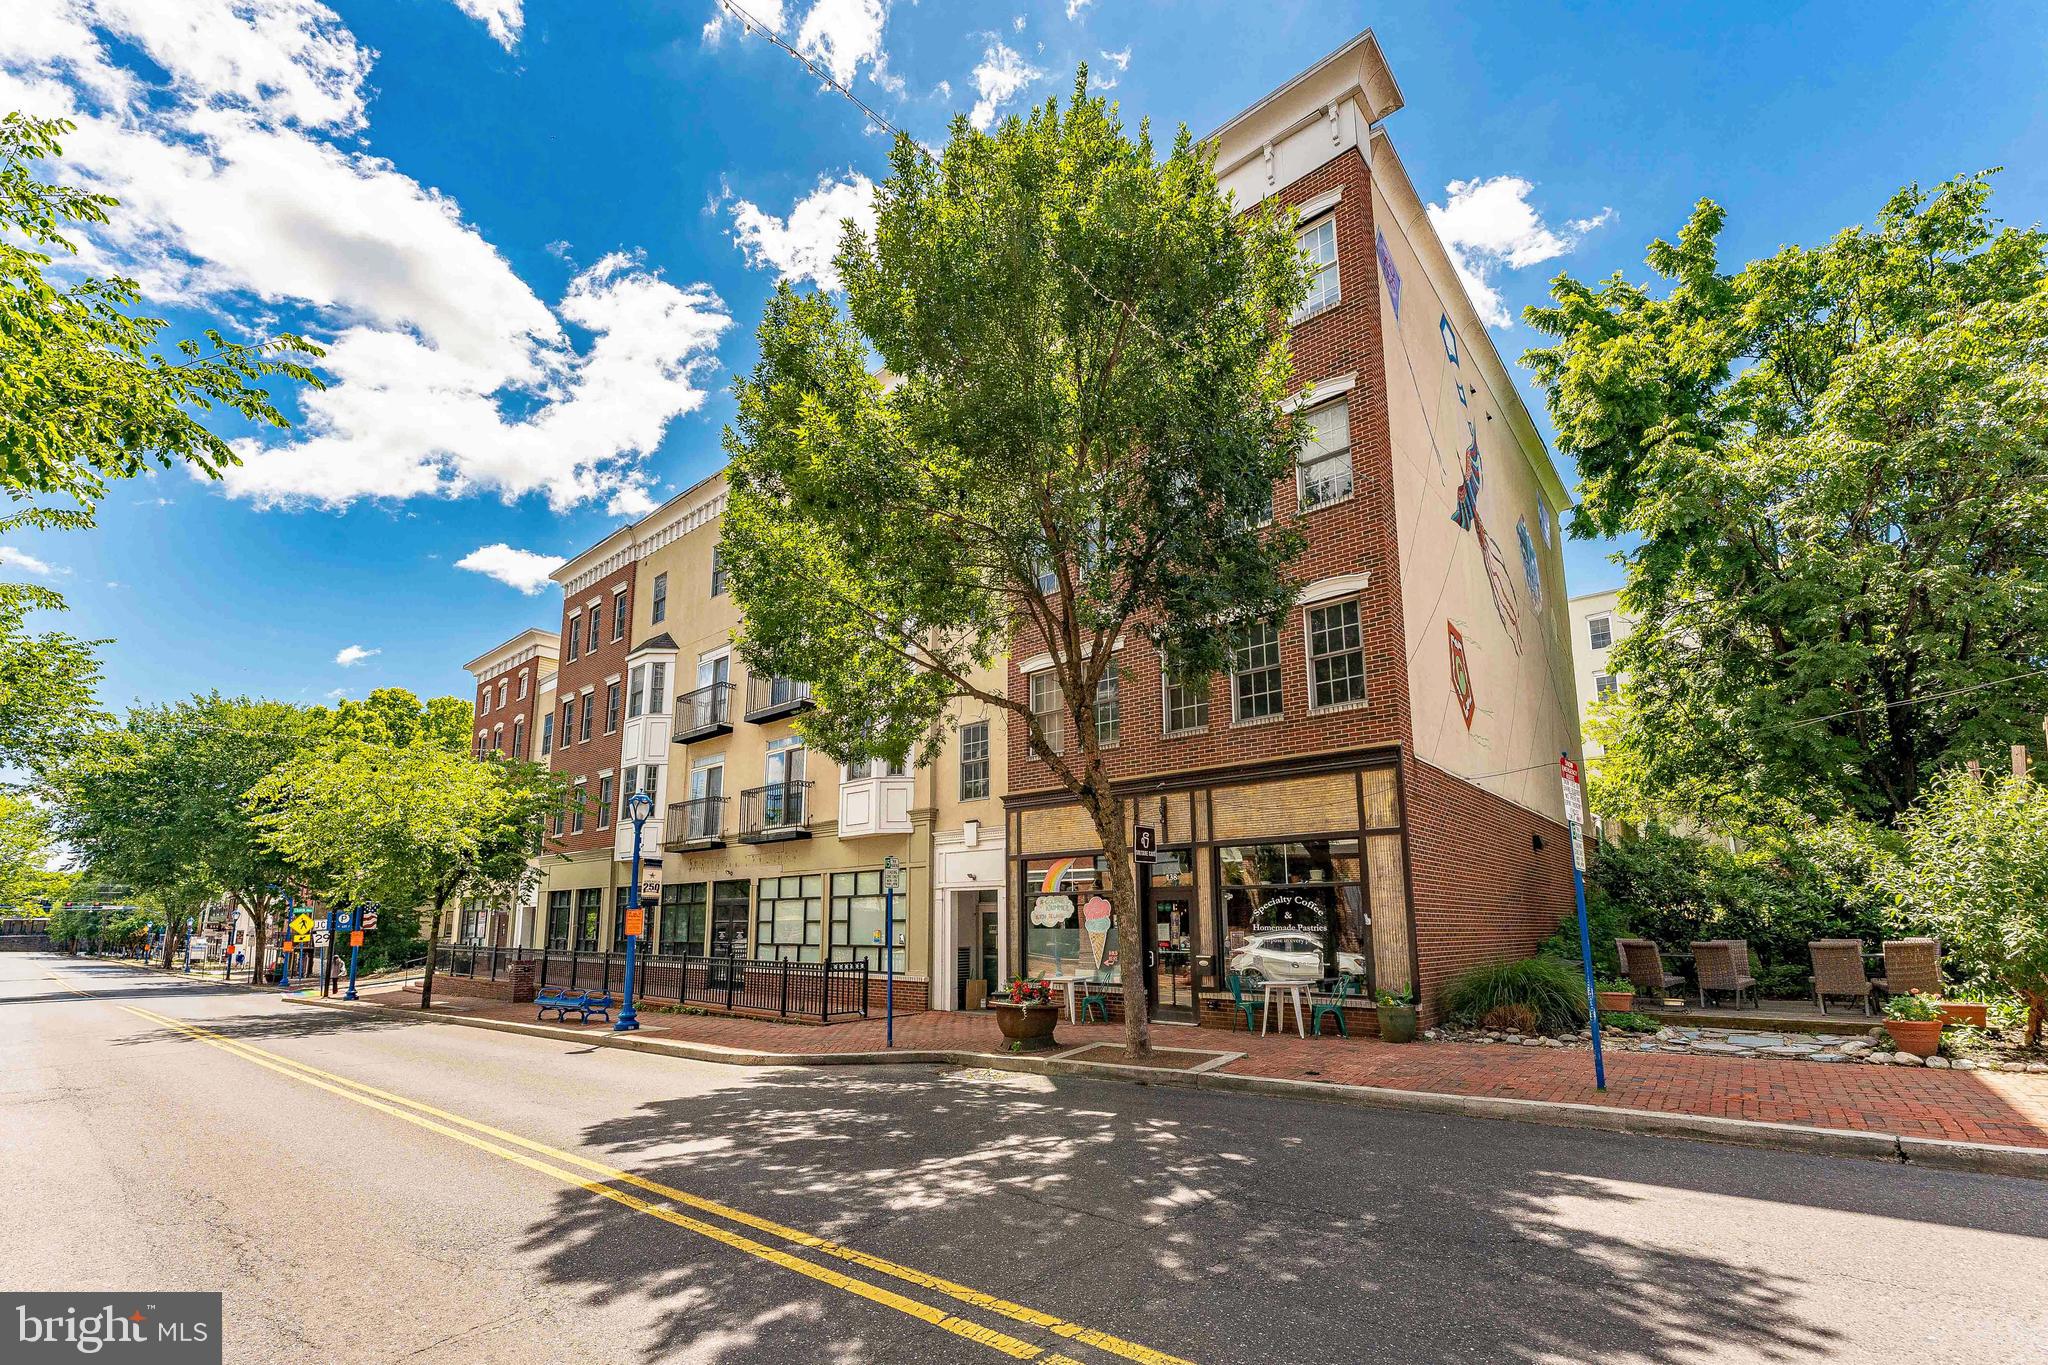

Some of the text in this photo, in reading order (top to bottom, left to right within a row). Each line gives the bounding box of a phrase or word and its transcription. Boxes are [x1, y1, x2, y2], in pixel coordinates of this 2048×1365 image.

[643, 883, 660, 893] 250
[1253, 895, 1324, 917] Specialty Coffee
[1284, 911, 1292, 919] &
[315, 934, 330, 943] 29
